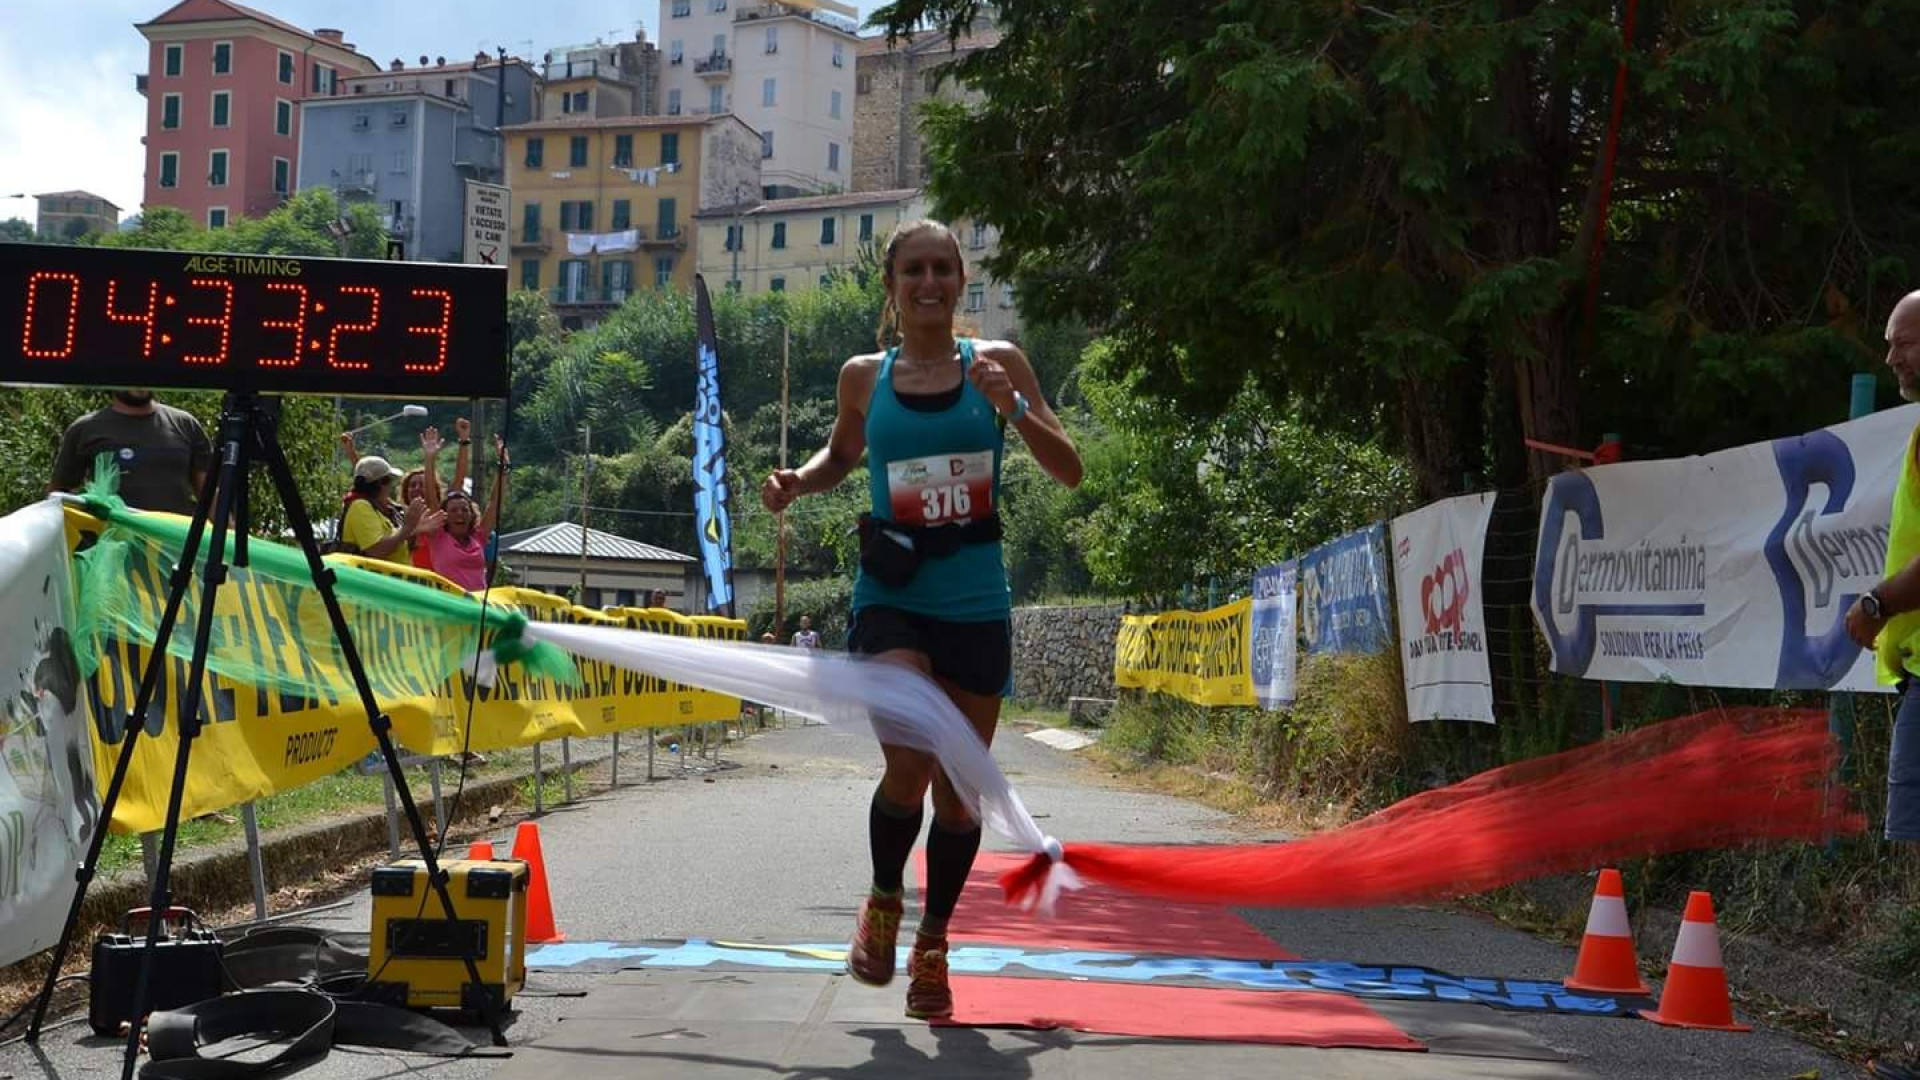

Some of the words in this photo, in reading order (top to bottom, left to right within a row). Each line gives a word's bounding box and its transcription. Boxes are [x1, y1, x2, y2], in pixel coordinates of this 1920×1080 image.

[475, 205, 502, 218] VIETATO
[184, 255, 301, 277] ALGE-TIMING
[921, 484, 971, 520] 376
[1558, 534, 1706, 614] Dermovitamina
[1600, 631, 1644, 658] SOLUZIONI
[1644, 631, 1663, 659] PER
[284, 727, 339, 767] PRODUCTS
